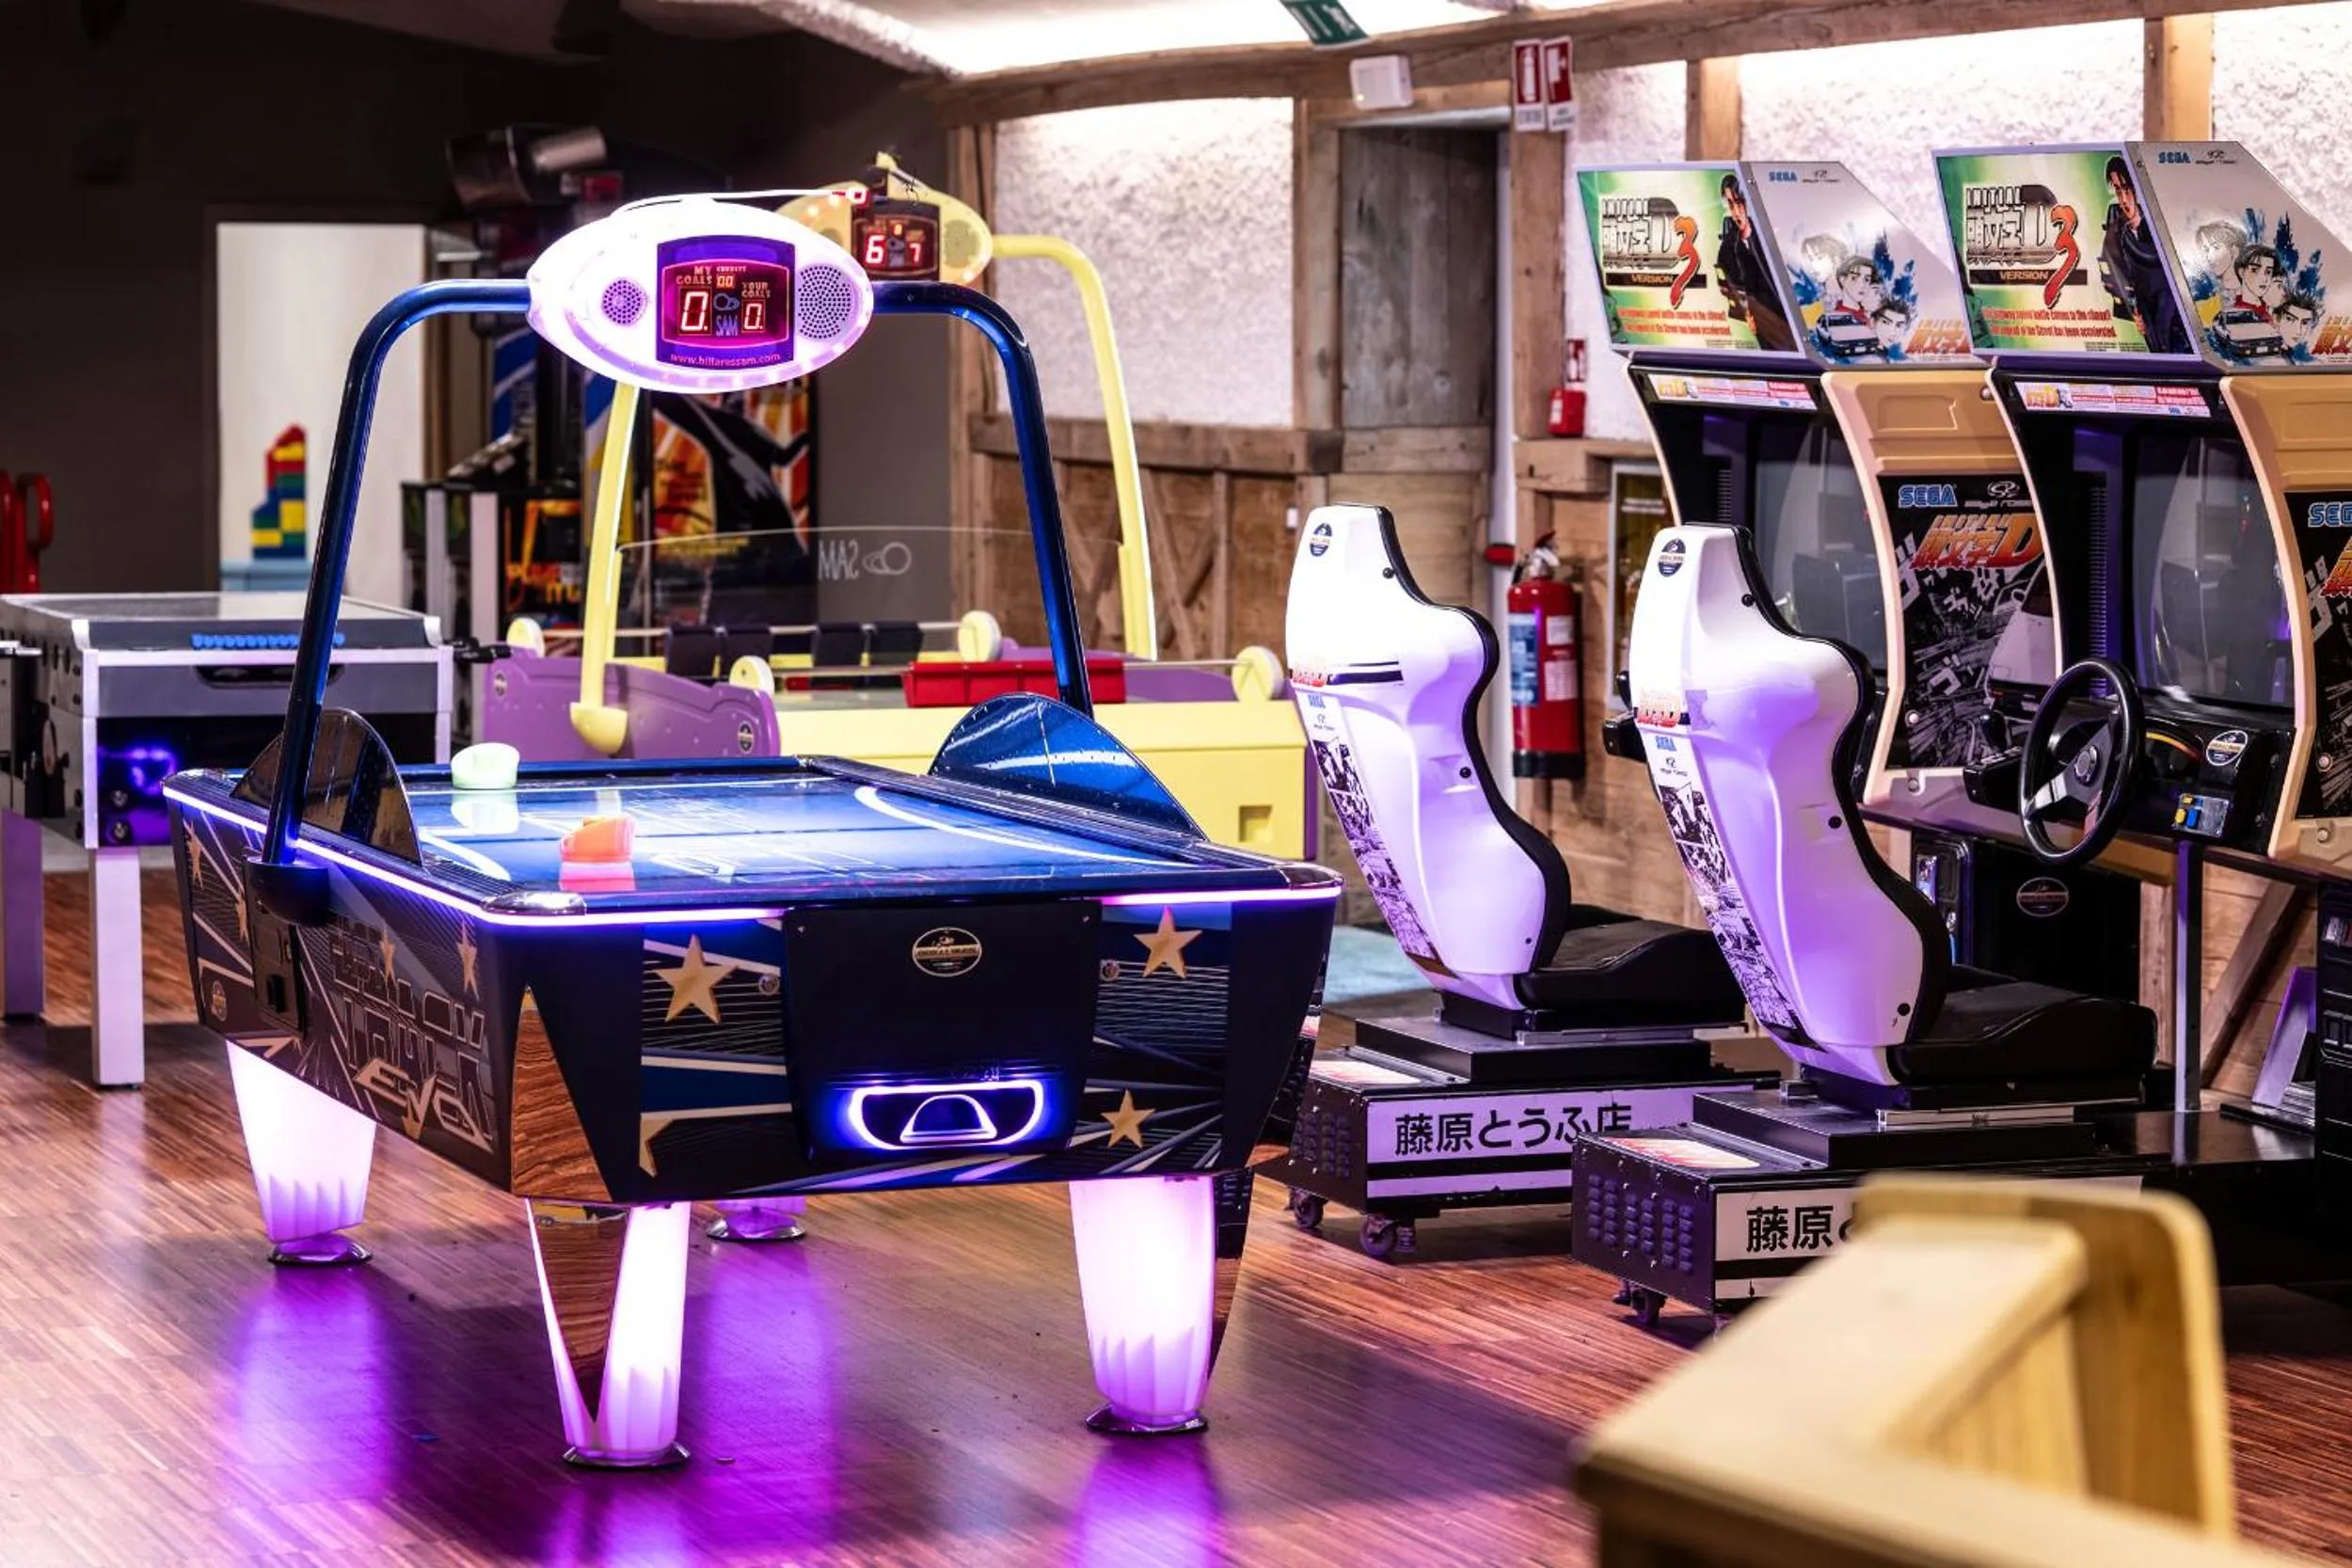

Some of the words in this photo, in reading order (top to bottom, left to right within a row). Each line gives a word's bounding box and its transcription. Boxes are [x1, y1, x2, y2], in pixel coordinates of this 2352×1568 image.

[693, 265, 712, 276] MY
[1631, 273, 1674, 284] VERSION
[2000, 270, 2049, 280] VERSION
[1899, 483, 1958, 509] SEGA
[2307, 501, 2352, 528] SEG
[1394, 1102, 1632, 1156] 藤原とうふ店
